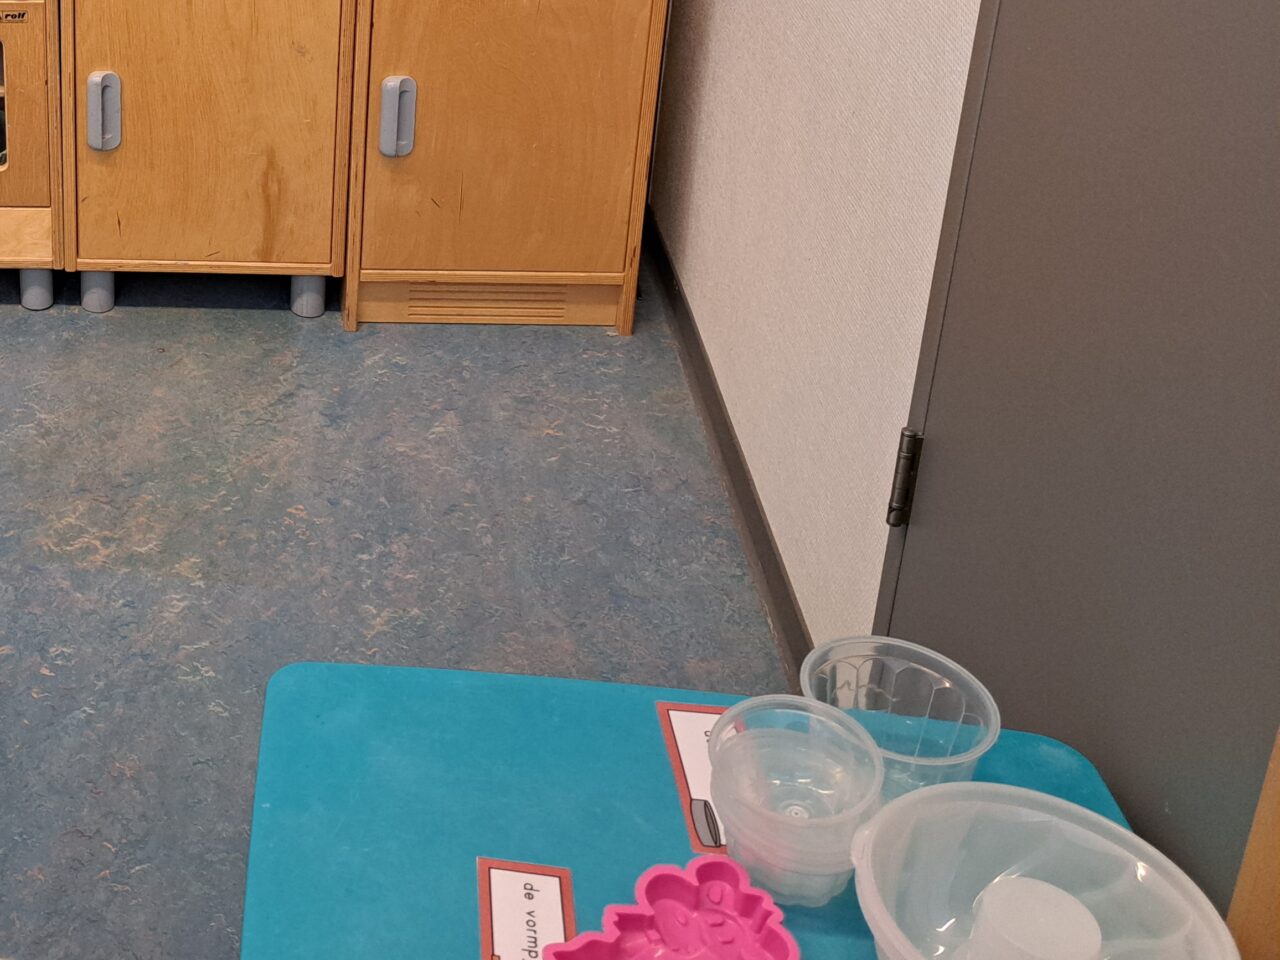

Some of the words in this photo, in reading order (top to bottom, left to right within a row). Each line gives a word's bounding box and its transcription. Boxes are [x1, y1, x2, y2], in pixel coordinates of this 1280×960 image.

[4, 11, 27, 20] rolf
[523, 882, 541, 901] de
[521, 910, 539, 960] vormp
